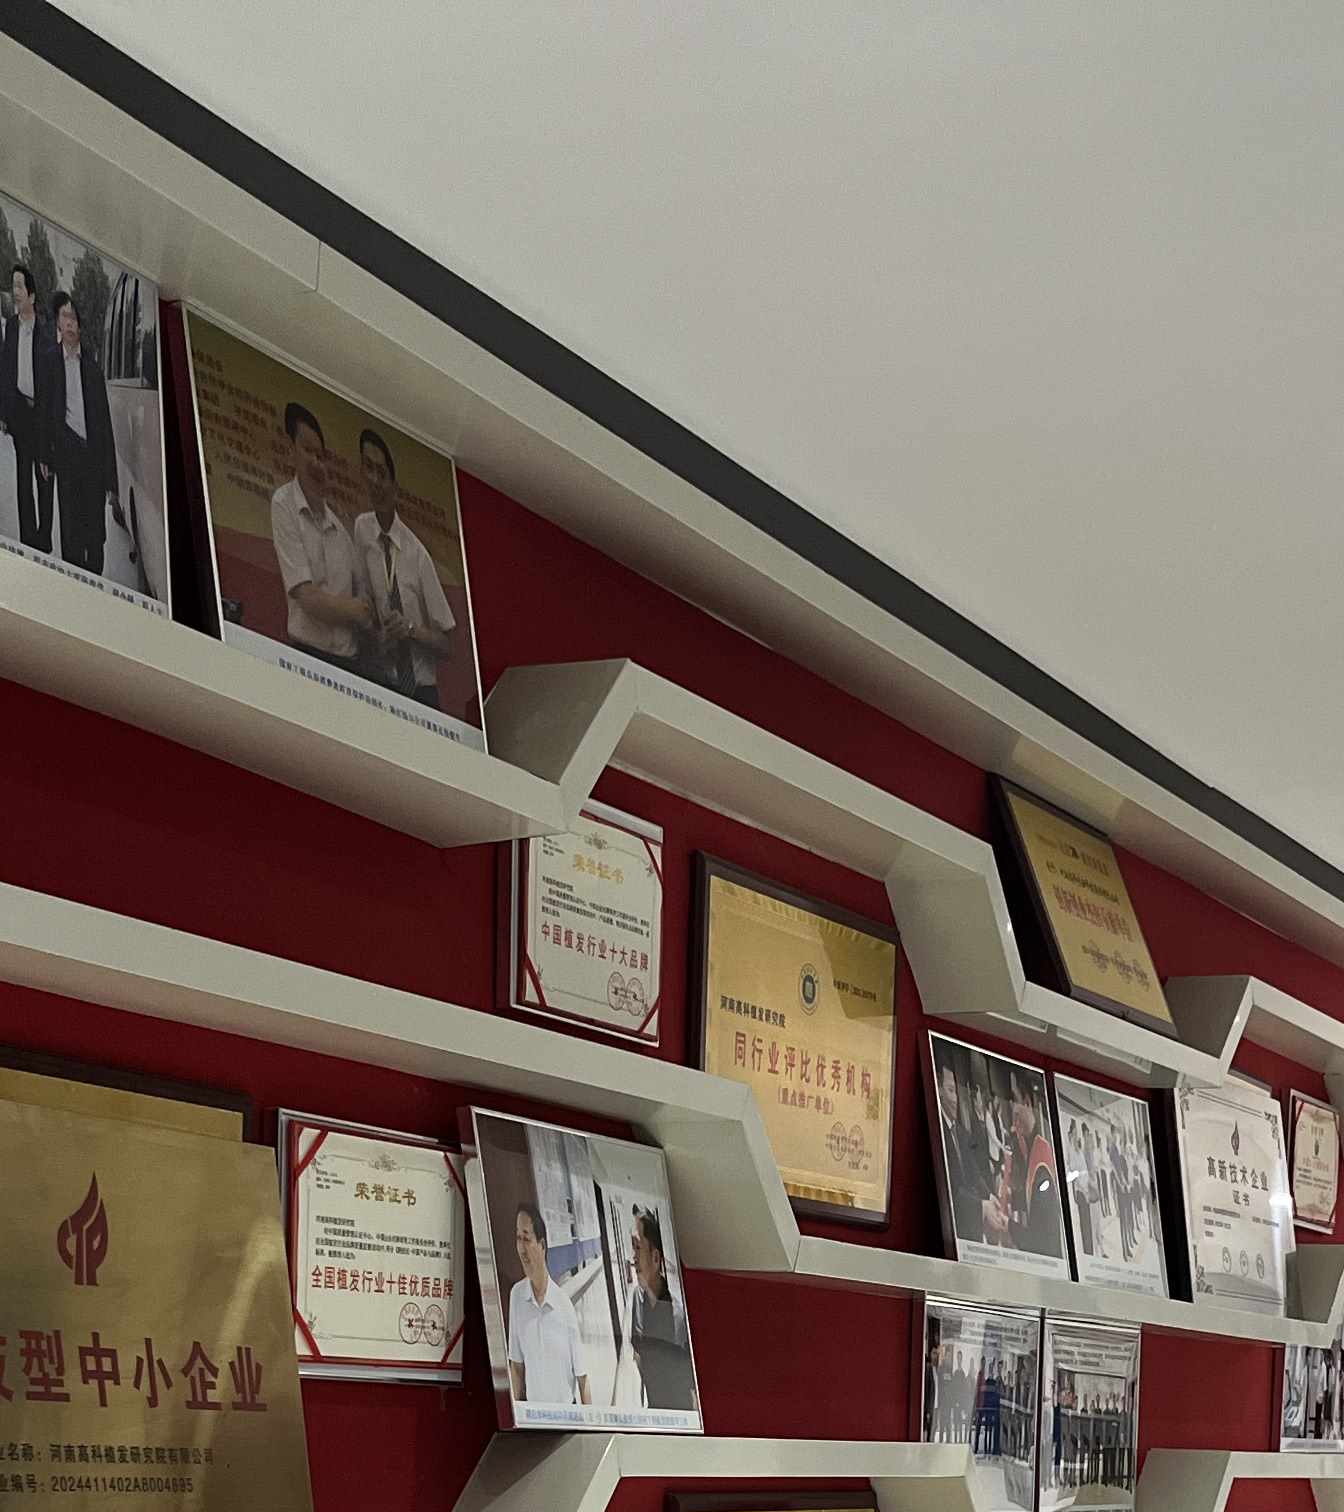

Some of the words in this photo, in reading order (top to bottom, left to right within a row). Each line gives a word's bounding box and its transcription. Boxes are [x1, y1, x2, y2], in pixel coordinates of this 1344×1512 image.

[541, 920, 649, 972] 中国植发行业十大品牌
[734, 1031, 872, 1099] 同行业评比优秀机构
[1206, 1155, 1270, 1192] 高新技术企业
[354, 1181, 417, 1207] 荣誉证书
[311, 1264, 455, 1300] 全国植发行业十佳优质品牌
